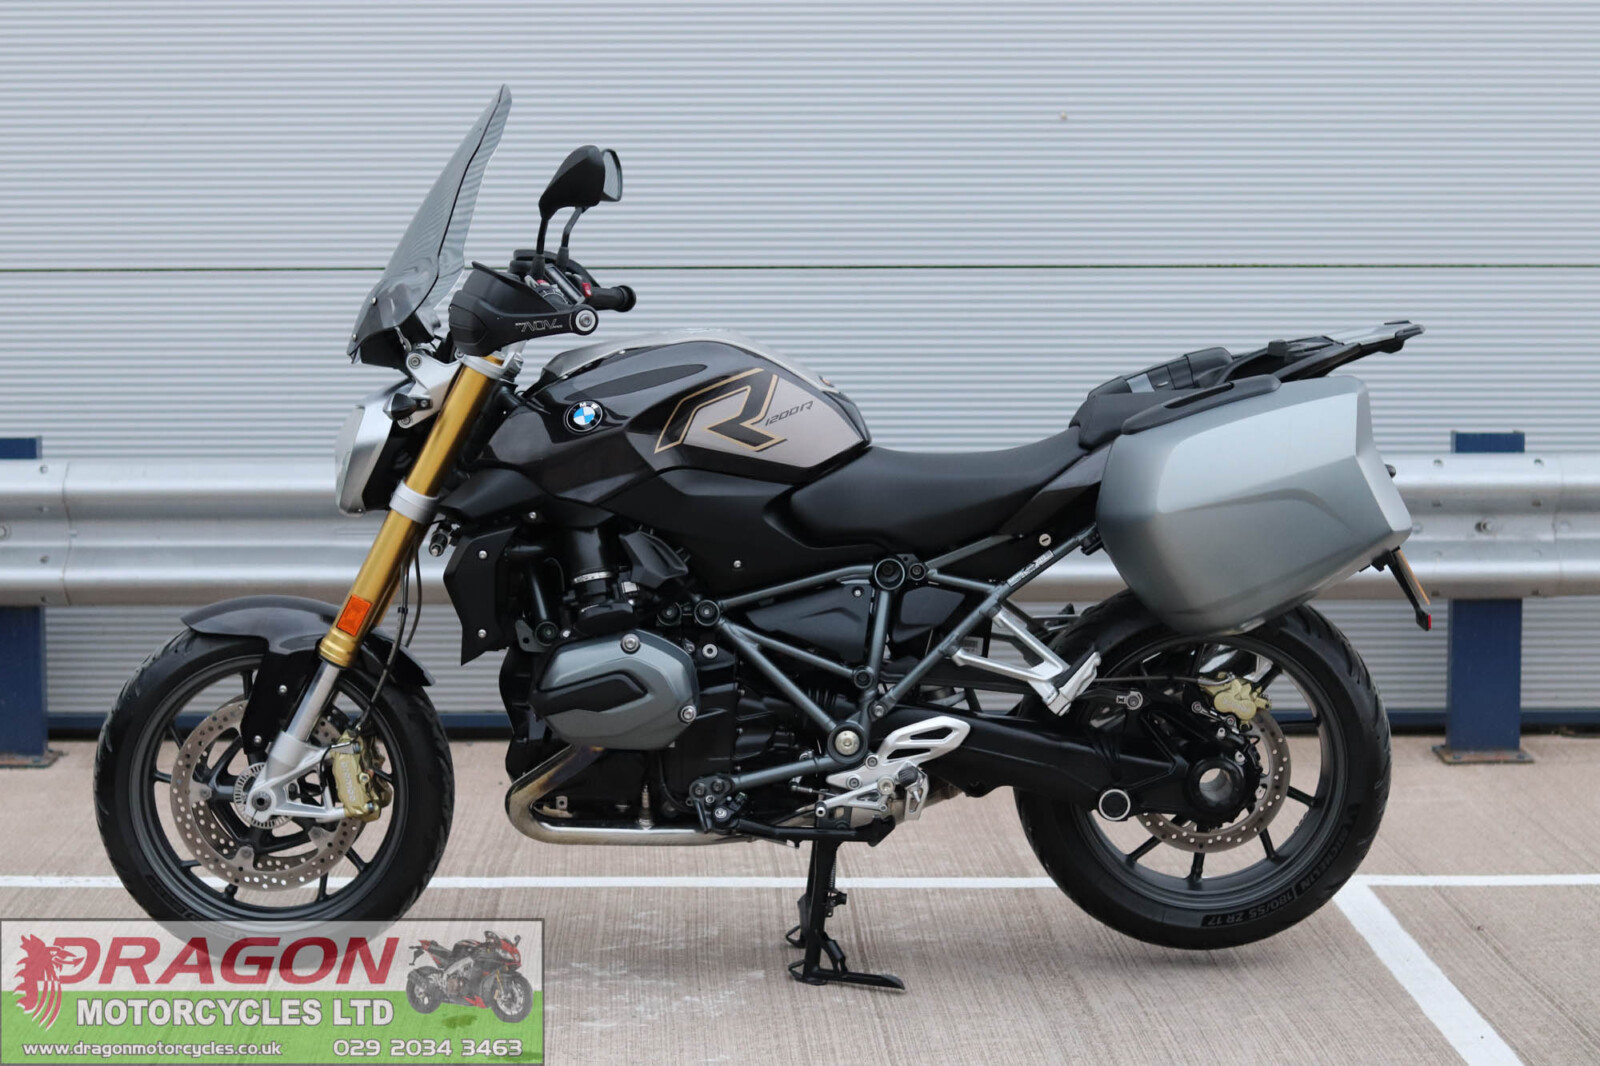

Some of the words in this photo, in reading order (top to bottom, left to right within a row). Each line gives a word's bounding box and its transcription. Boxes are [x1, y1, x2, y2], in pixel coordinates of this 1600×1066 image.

[1247, 890, 1293, 919] 180/55
[1207, 915, 1222, 926] 17
[1226, 911, 1244, 924] ZR
